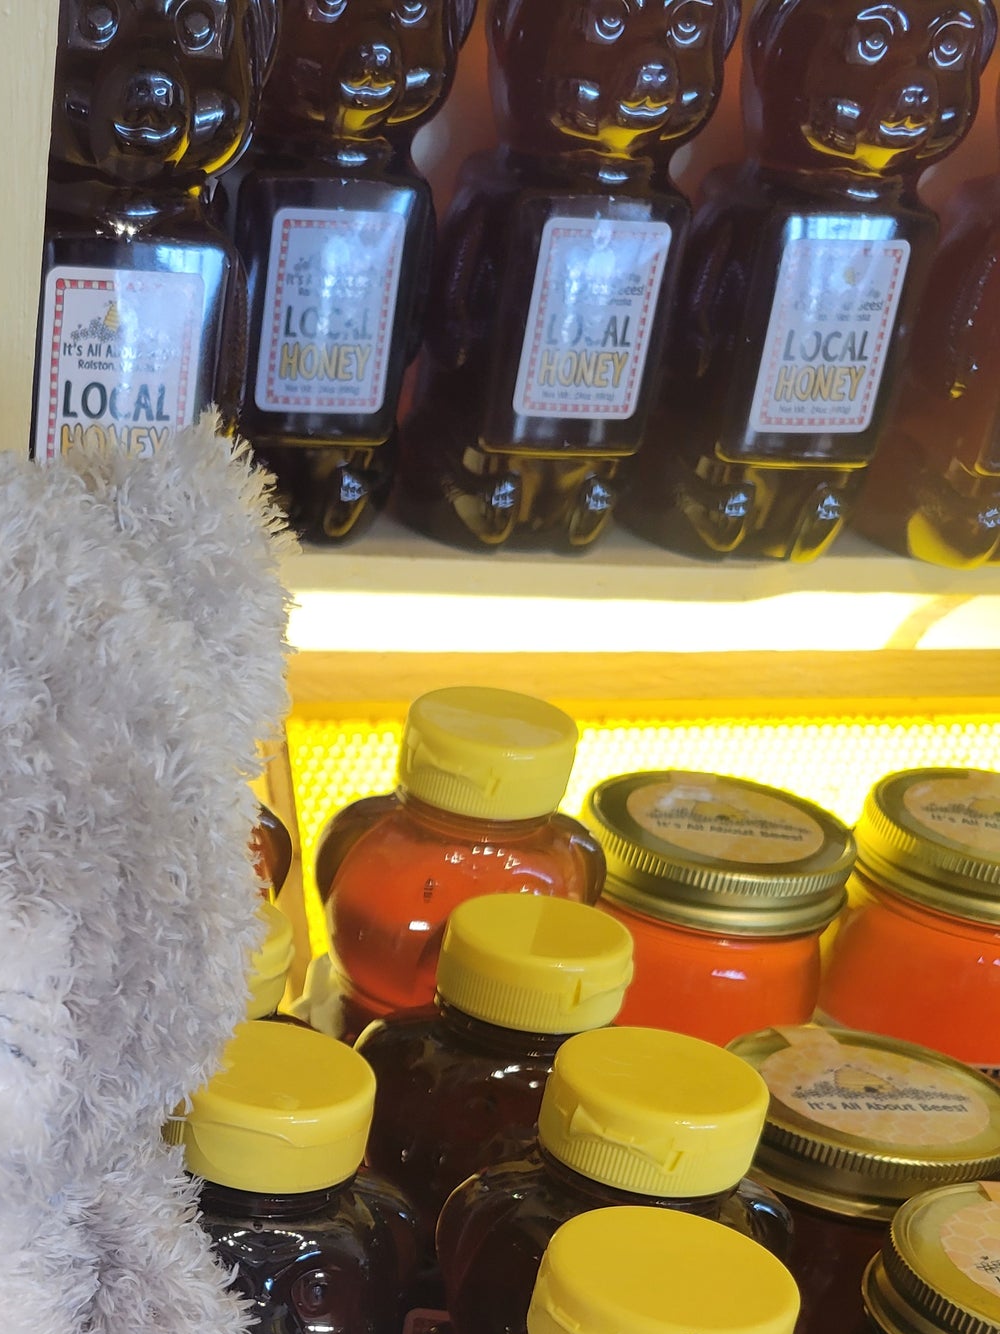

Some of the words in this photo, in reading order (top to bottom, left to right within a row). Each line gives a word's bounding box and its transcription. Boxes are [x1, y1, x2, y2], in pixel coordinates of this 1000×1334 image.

[63, 342, 83, 357] It's
[87, 343, 102, 357] All
[279, 341, 372, 382] HONEY
[782, 328, 869, 363] LOCAL
[538, 348, 630, 389] HONEY
[773, 364, 867, 402] HONEY
[62, 379, 171, 422] LOCAL
[807, 1101, 837, 1112] It's
[842, 1102, 862, 1112] All
[866, 1102, 917, 1113] About
[918, 1103, 969, 1114] Bees!
